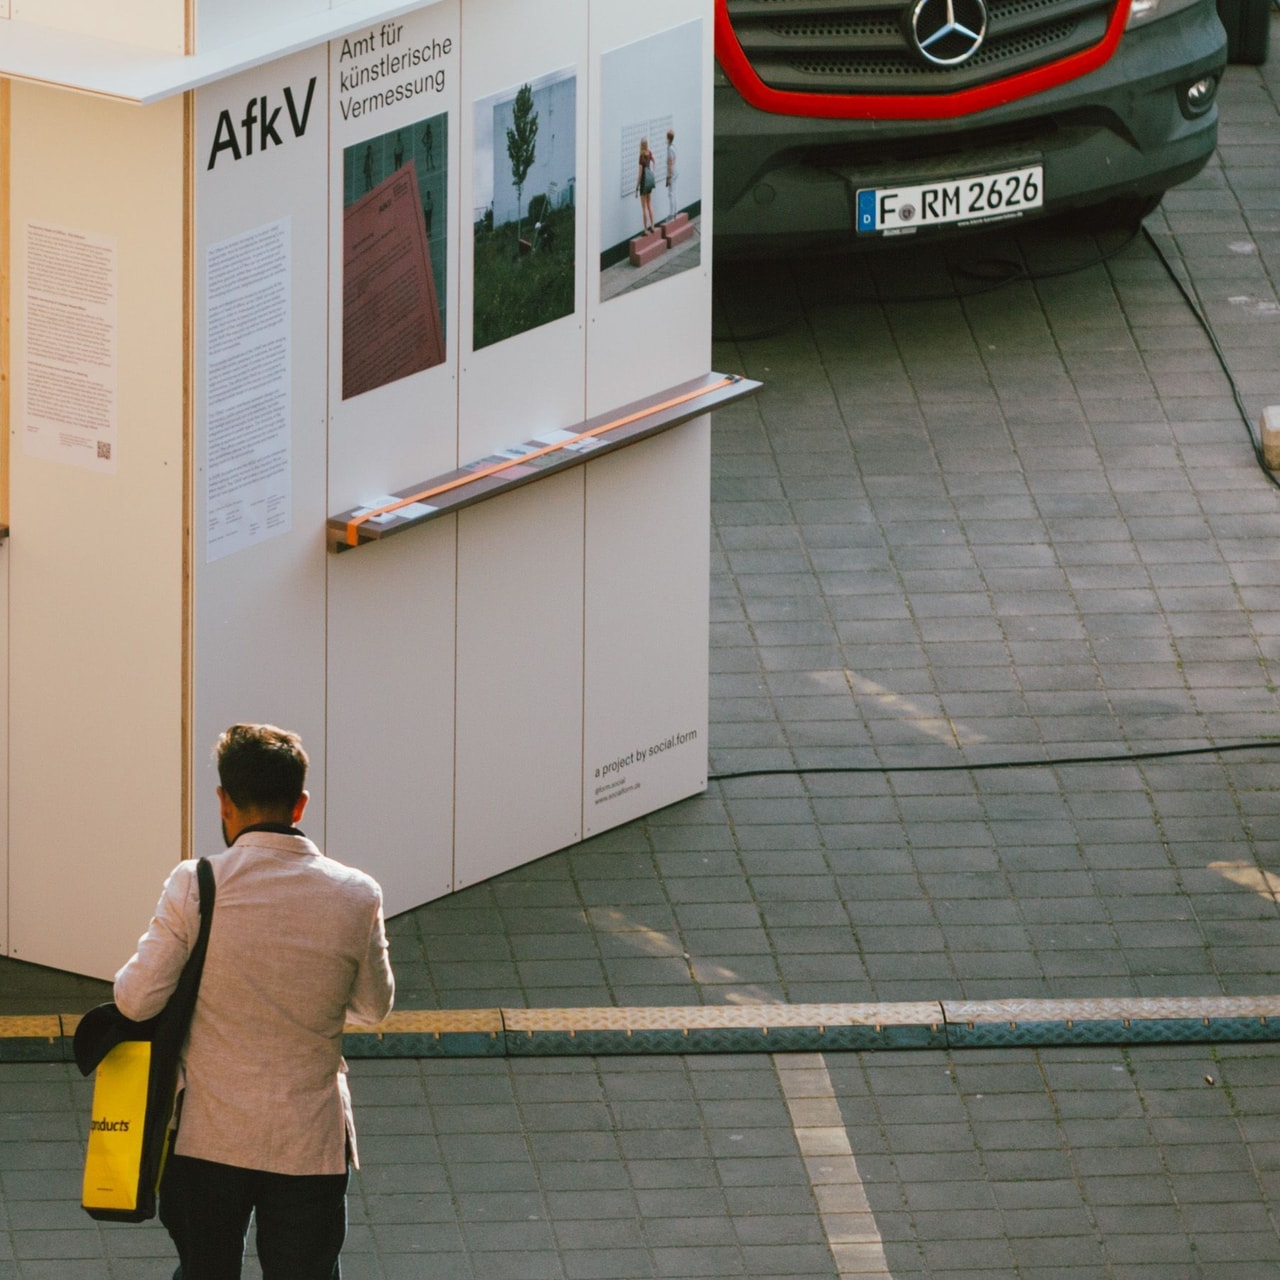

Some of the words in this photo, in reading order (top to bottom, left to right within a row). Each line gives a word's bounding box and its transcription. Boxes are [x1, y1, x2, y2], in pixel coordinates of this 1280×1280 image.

[339, 36, 375, 63] Amt
[380, 22, 404, 48] für
[339, 37, 453, 94] künstlerische
[339, 69, 446, 122] Vermessung
[207, 76, 318, 172] AfkV
[863, 214, 871, 224] D
[880, 194, 899, 225] F
[921, 186, 961, 220] RM
[968, 172, 1039, 213] 2626
[594, 766, 601, 778] a
[602, 753, 634, 778] project
[636, 749, 647, 762] by
[648, 729, 698, 757] social.form
